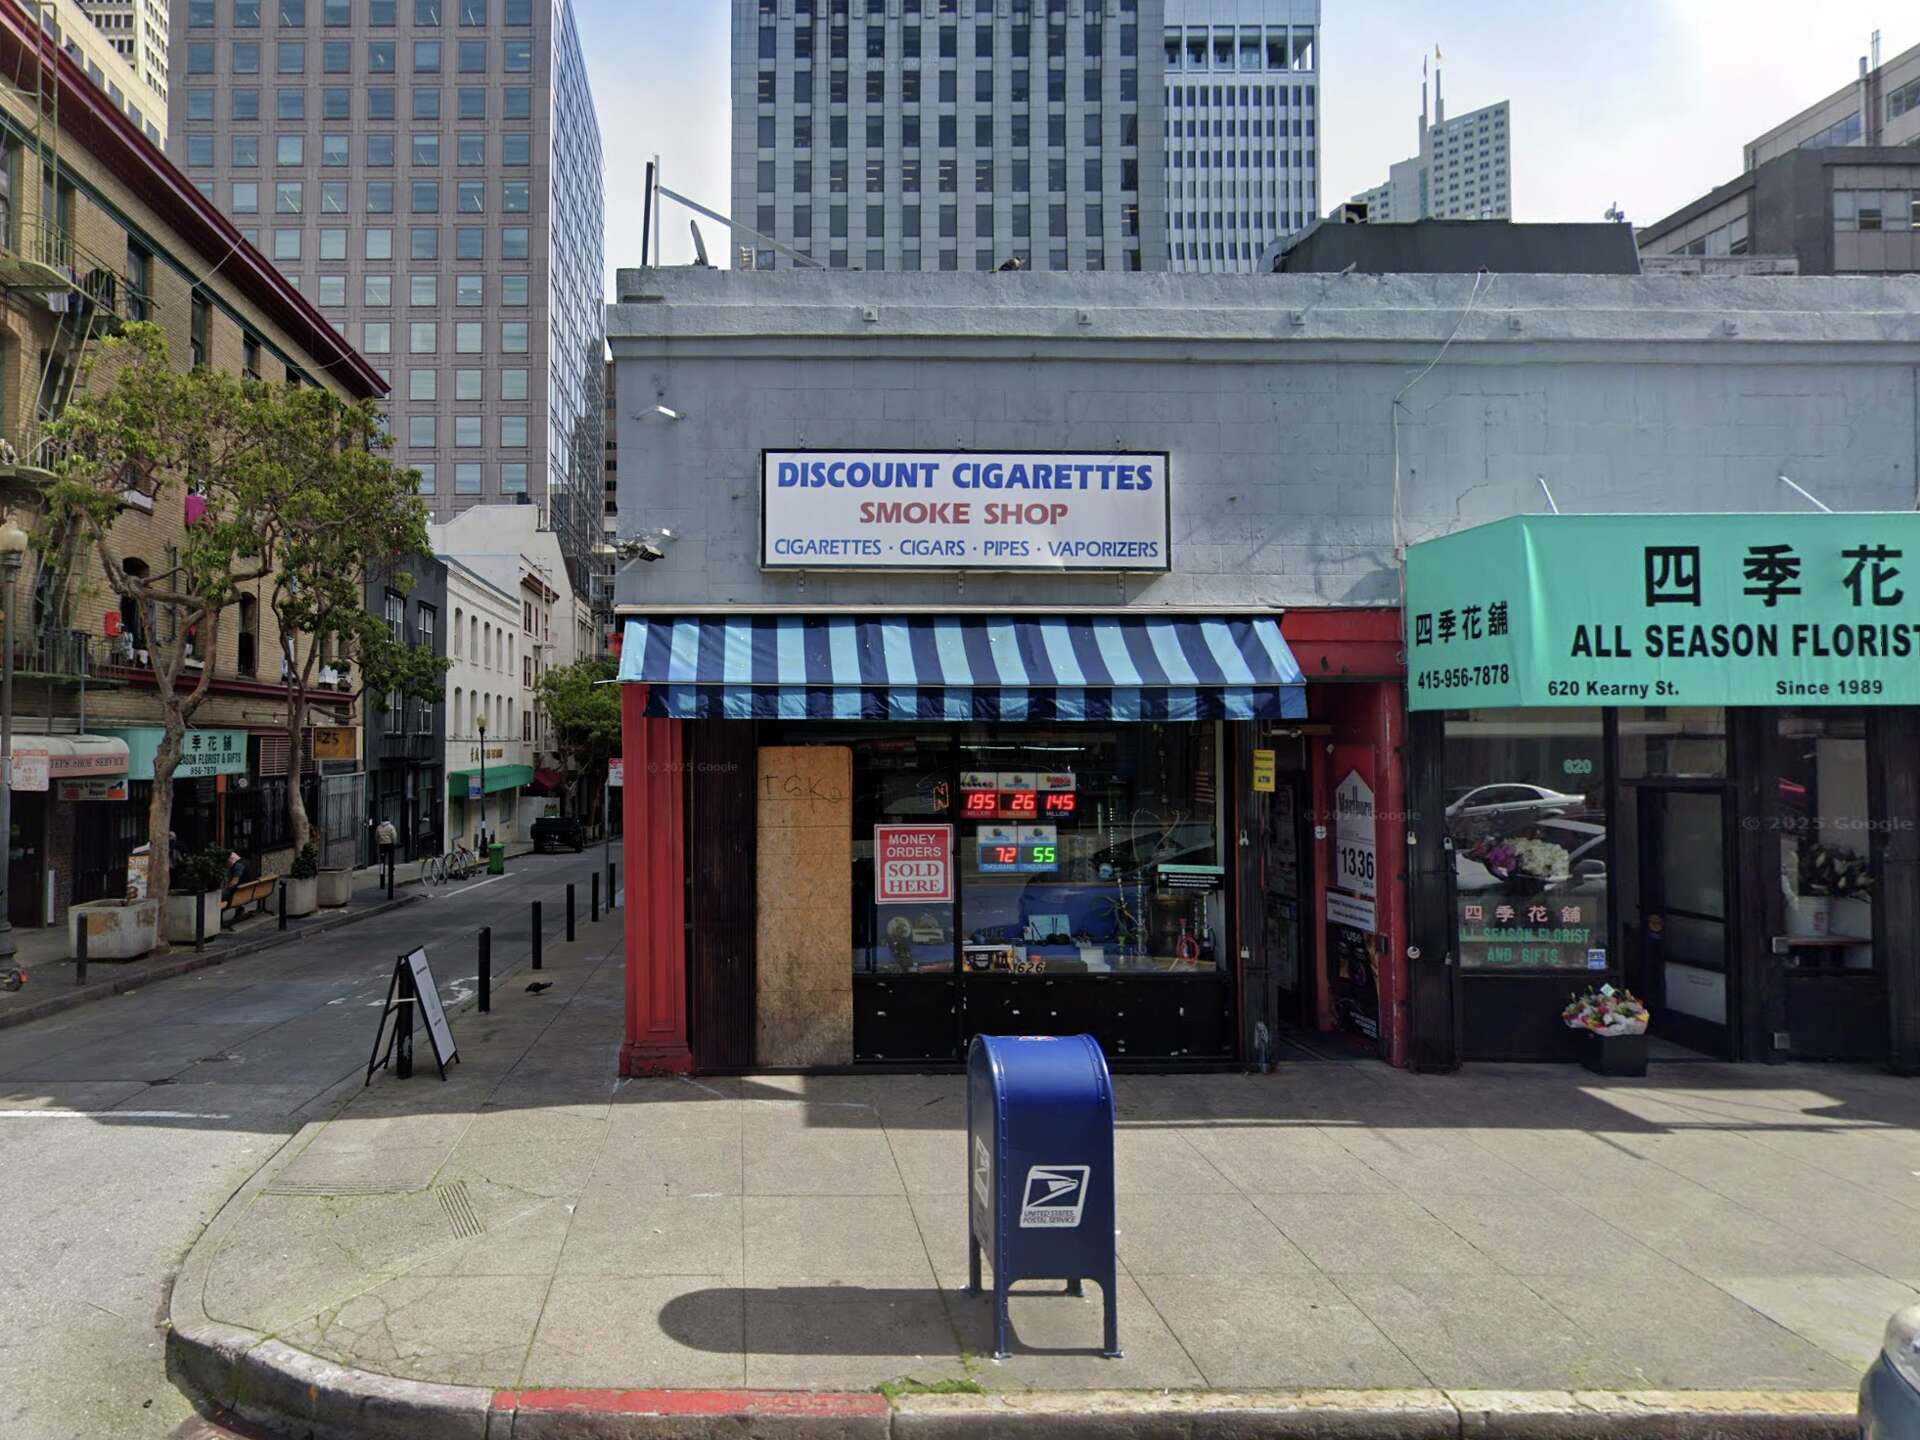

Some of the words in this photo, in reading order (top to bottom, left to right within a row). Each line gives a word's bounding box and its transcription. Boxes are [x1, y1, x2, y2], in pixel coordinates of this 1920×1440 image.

[777, 461, 939, 488] DISCOUNT
[952, 463, 1153, 491] CIGARETTES
[859, 501, 971, 525] SMOKE
[984, 502, 1069, 526] SHOP
[774, 538, 882, 556] CIGARETTES
[900, 539, 965, 557] CIGARS
[984, 540, 1030, 557] PIPES
[1048, 540, 1159, 558] VAPORIZERS
[1644, 544, 1905, 608] 四季花
[1570, 624, 1632, 658] ALL
[1645, 624, 1778, 658] SEASON
[1418, 663, 1509, 689] 415-956-7878
[1548, 680, 1580, 696] 620
[1586, 680, 1649, 699] Kearny
[1655, 680, 1680, 696] St.
[1776, 680, 1829, 696] Since
[1838, 680, 1883, 695] 1989
[967, 793, 996, 810] 195
[1011, 794, 1035, 810] 26
[1045, 794, 1075, 810] 145
[888, 833, 936, 845] MONEY
[886, 846, 942, 858] ORDERS
[995, 846, 1018, 864] 72
[1032, 846, 1056, 863] 55
[888, 863, 940, 878] SOLD
[888, 880, 941, 892] HERE
[1483, 927, 1533, 943] SEASON
[1537, 927, 1591, 944] FLORIST
[1487, 947, 1512, 962] AND
[1520, 947, 1559, 964] GIFTS
[1023, 1216, 1048, 1224] POSTAL
[1049, 1215, 1076, 1224] SERVICE
[1024, 1209, 1049, 1217] UNITED
[1050, 1209, 1074, 1217] STATES
